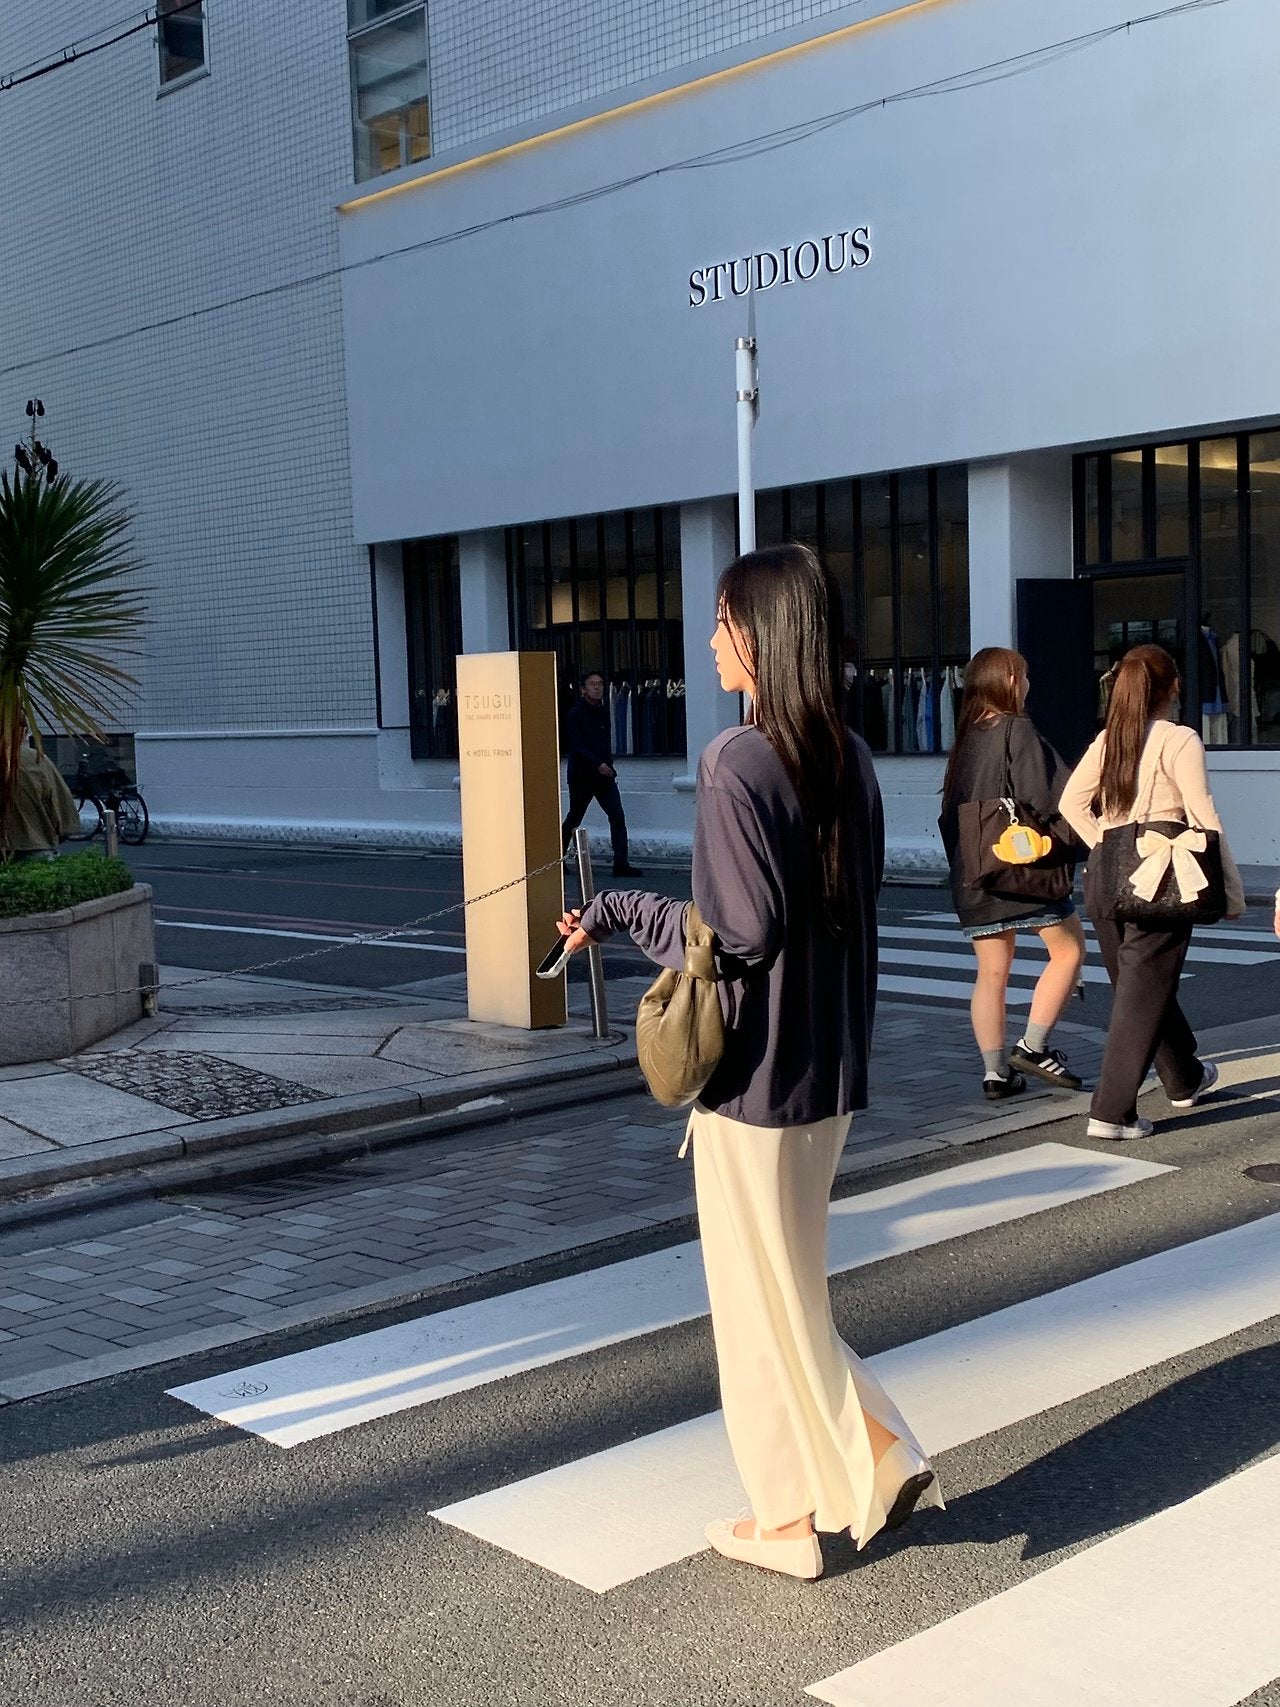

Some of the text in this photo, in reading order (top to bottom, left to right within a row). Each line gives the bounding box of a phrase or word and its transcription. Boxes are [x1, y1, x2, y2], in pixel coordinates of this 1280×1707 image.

[689, 226, 871, 308] STUDIOUS
[464, 694, 511, 709] TSUGU
[473, 749, 512, 757] HOTEL FRONT
